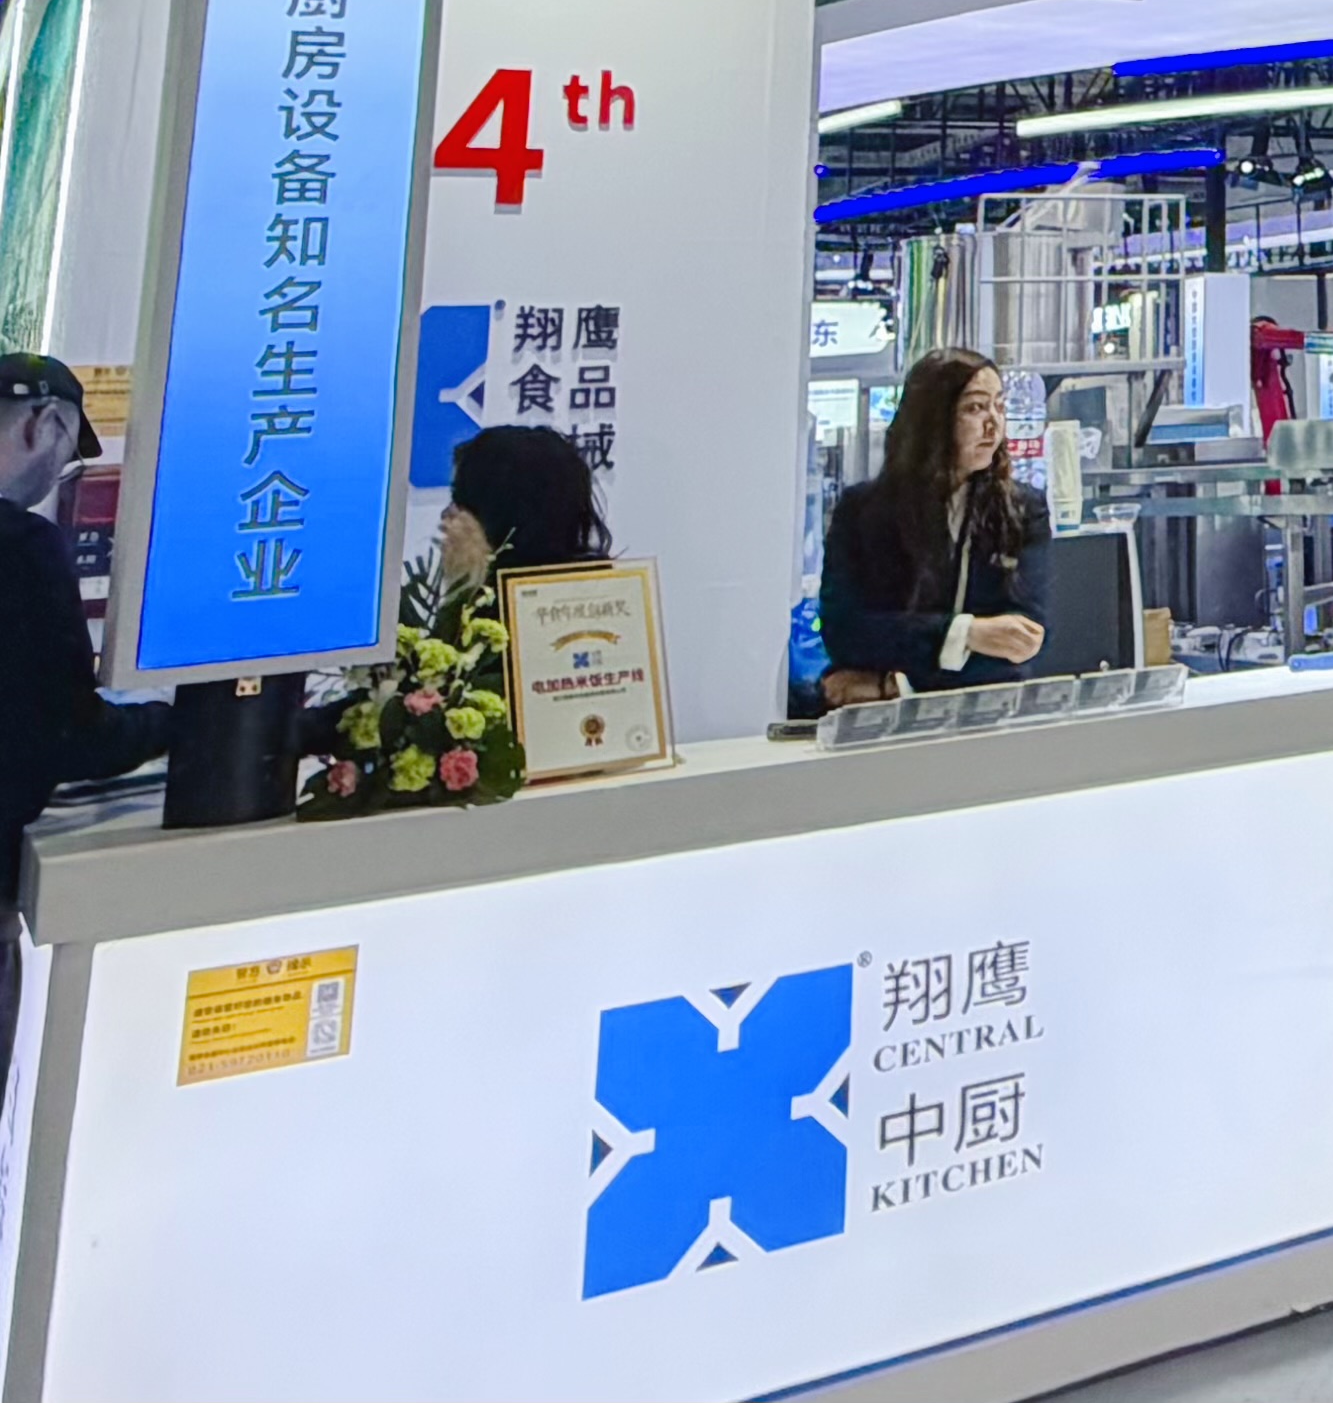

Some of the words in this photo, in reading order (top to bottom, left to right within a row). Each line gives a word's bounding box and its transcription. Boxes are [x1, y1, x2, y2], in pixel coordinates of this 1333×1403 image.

[433, 68, 636, 205] 4th
[513, 304, 621, 352] 翔鹰
[509, 363, 617, 415] 食品
[531, 667, 645, 695] 电加热米饭生产线
[882, 940, 1030, 1032] 翔鹰
[873, 1014, 1045, 1074] CENTRAL
[879, 1071, 1027, 1168] 中厨
[871, 1142, 1045, 1213] KITCHEN
